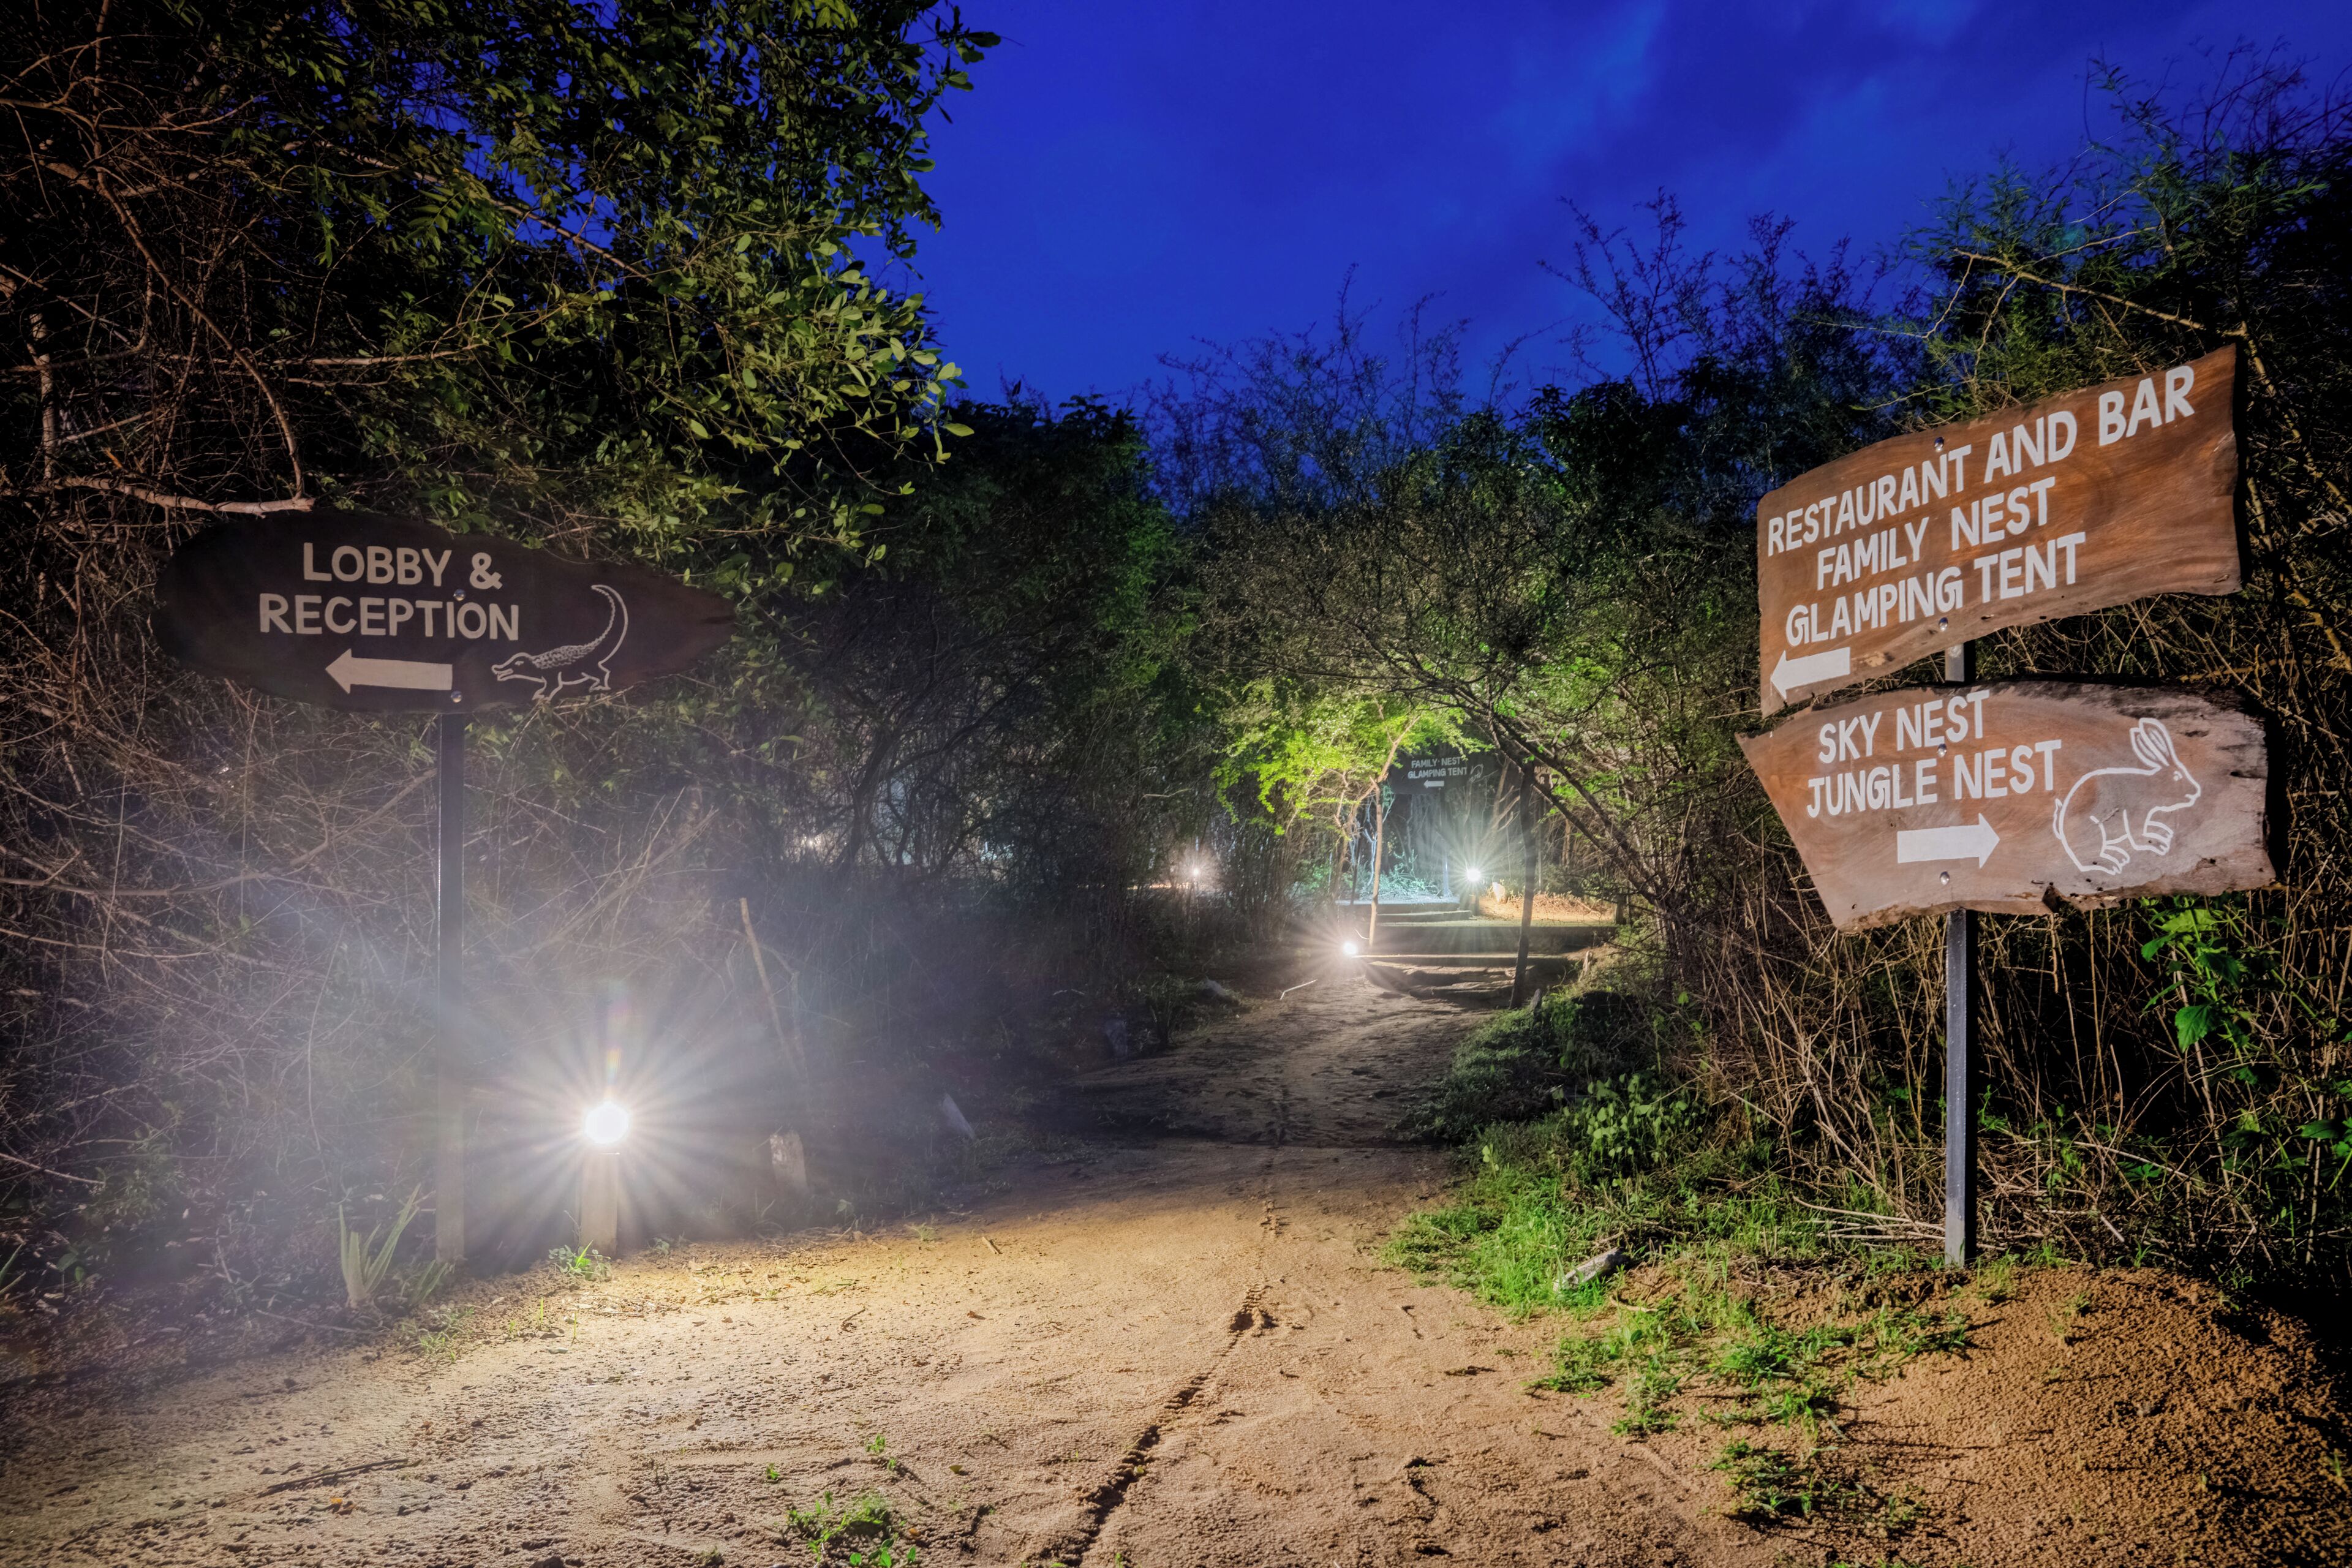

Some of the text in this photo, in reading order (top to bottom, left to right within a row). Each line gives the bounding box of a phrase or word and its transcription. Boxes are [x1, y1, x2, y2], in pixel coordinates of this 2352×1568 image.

[1768, 366, 2195, 557] RESTAURANT AND BAR
[304, 542, 503, 590] LOBBY &
[1817, 477, 2056, 590] FAMILY NEST
[259, 593, 519, 641] RECEPTION
[1786, 532, 2085, 647] GLAMPING TENT
[1412, 758, 1437, 768] FAMILY
[1819, 690, 1989, 764] SKY NEST
[1408, 767, 1467, 778] GLAMPING TENT
[1806, 739, 2062, 818] JUNGLE NEST
